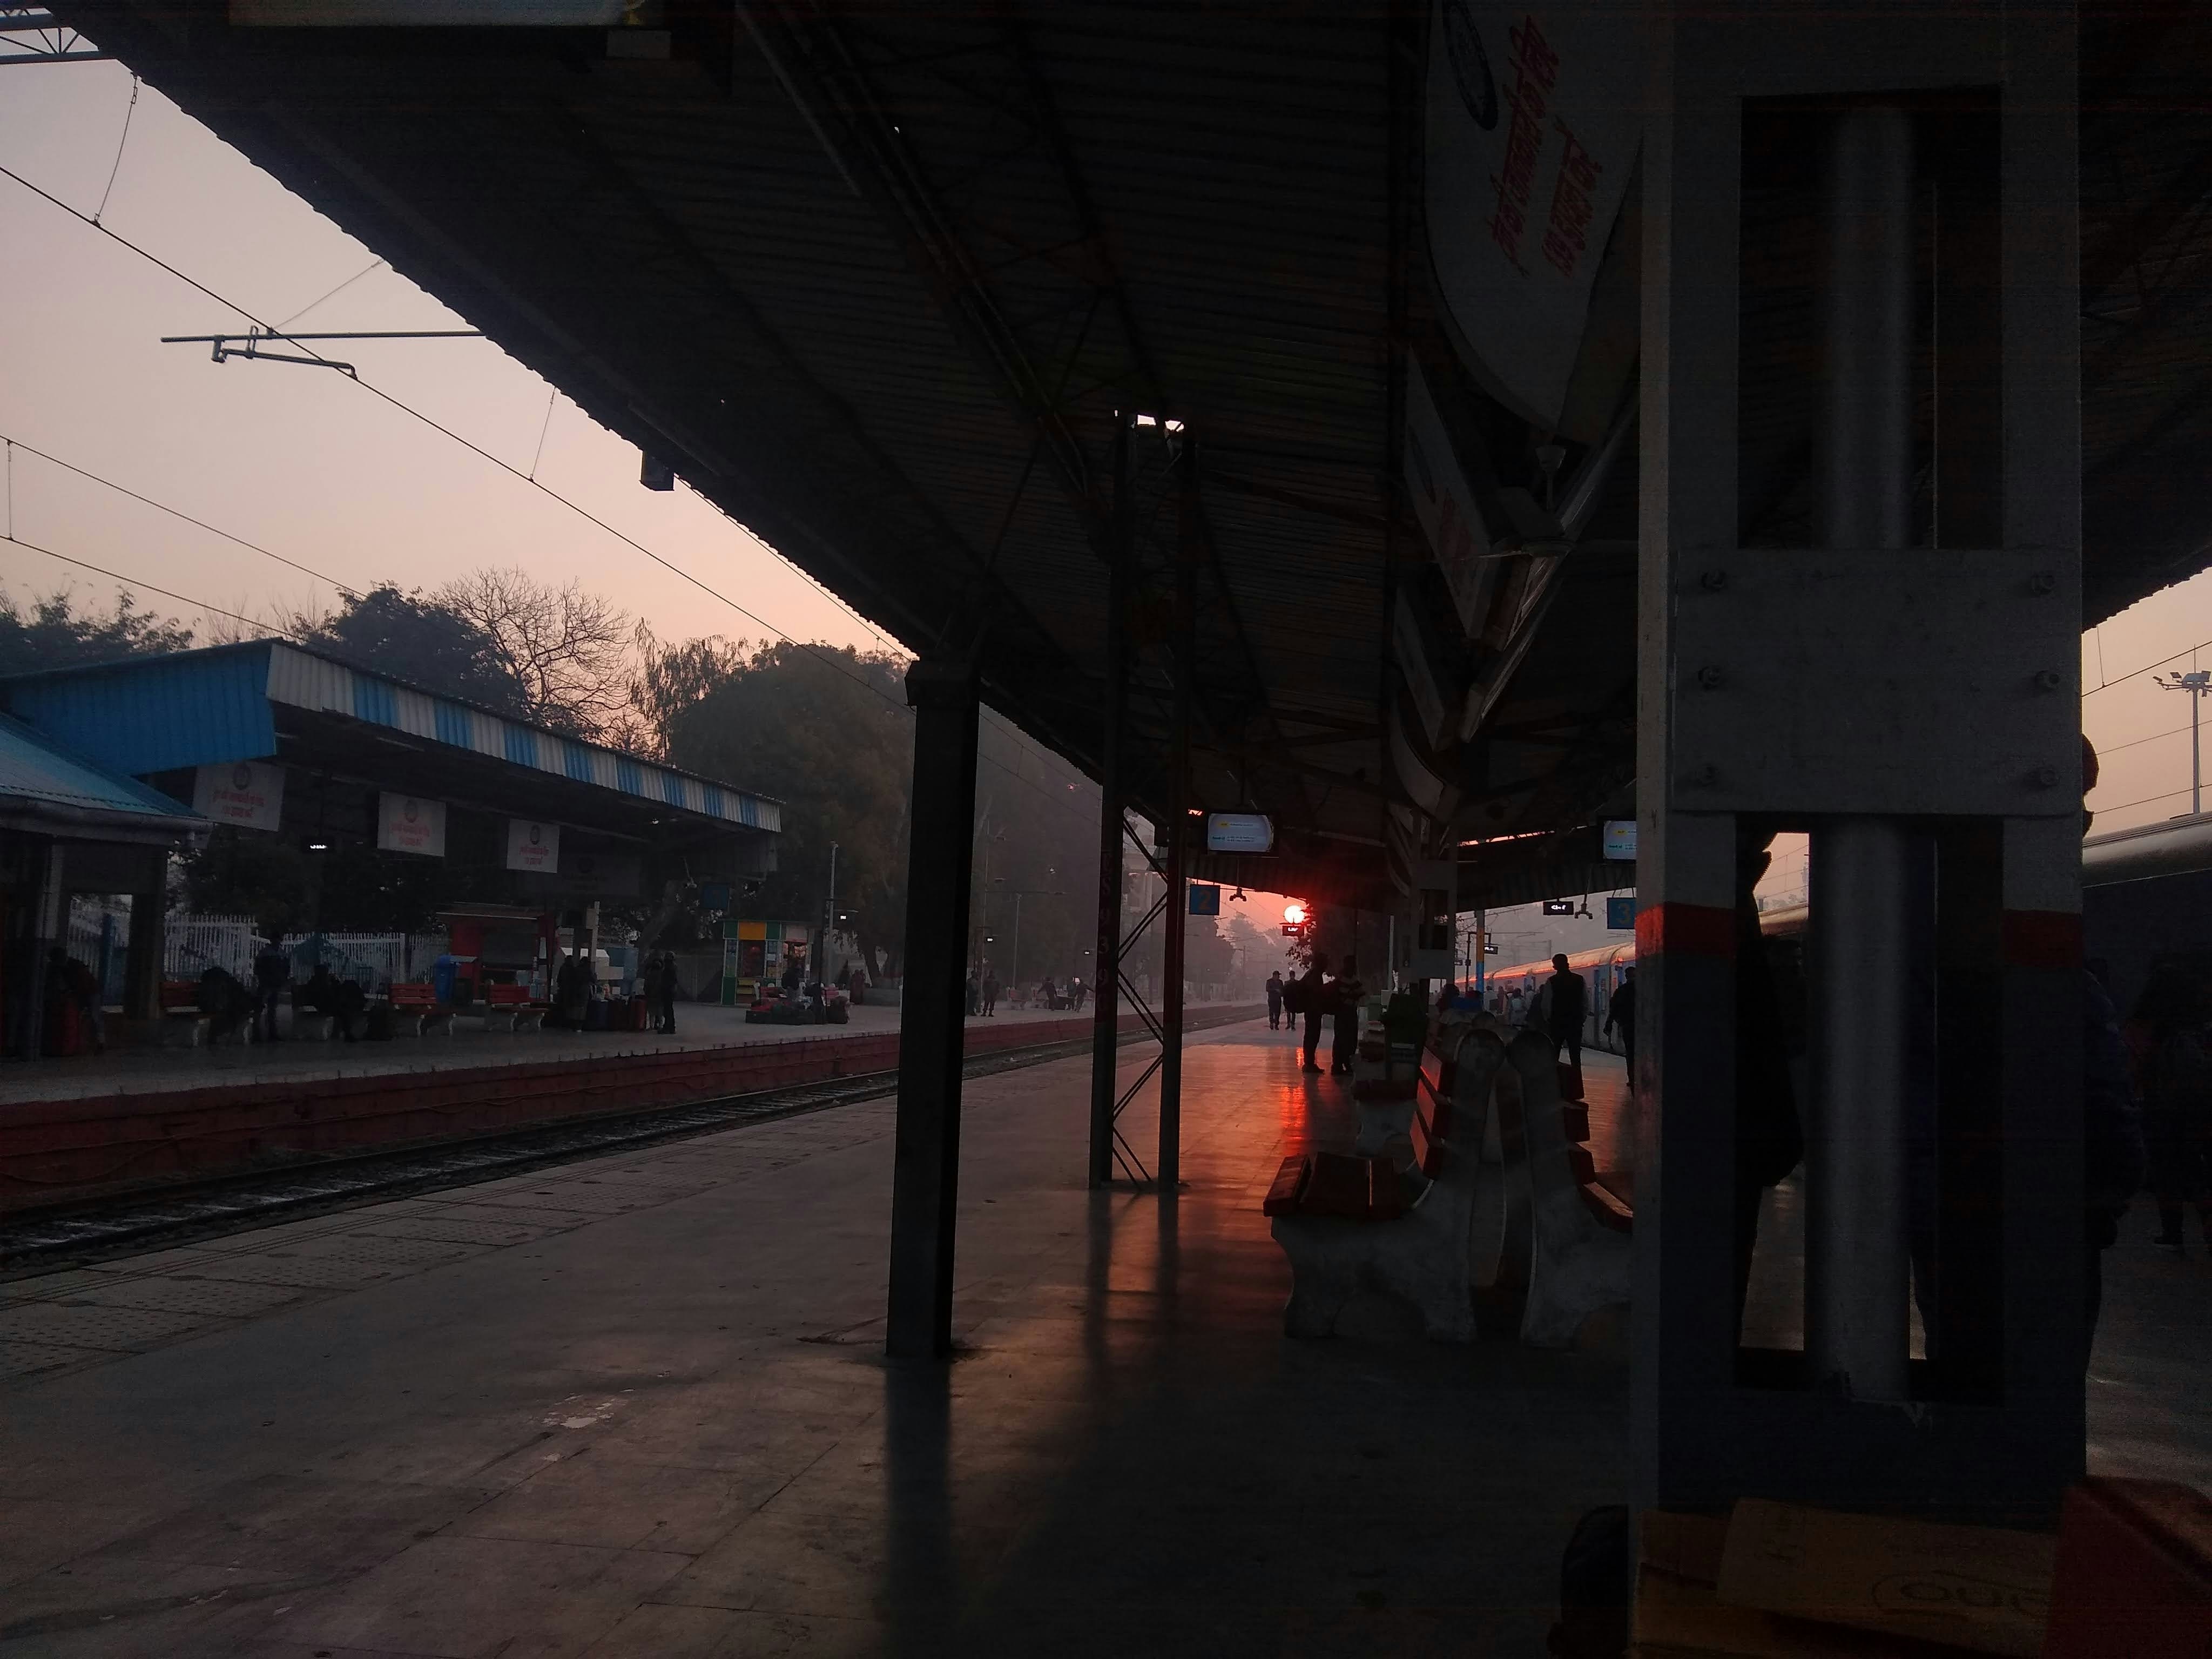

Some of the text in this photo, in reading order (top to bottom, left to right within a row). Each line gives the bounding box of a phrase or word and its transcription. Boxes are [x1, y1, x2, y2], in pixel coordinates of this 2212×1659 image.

[1508, 56, 1545, 119] के
[1501, 85, 1542, 208] जानकारी
[1489, 173, 1526, 236] की
[1541, 231, 1576, 279] 139
[1199, 889, 1211, 911] 2
[1616, 902, 1630, 925] 3
